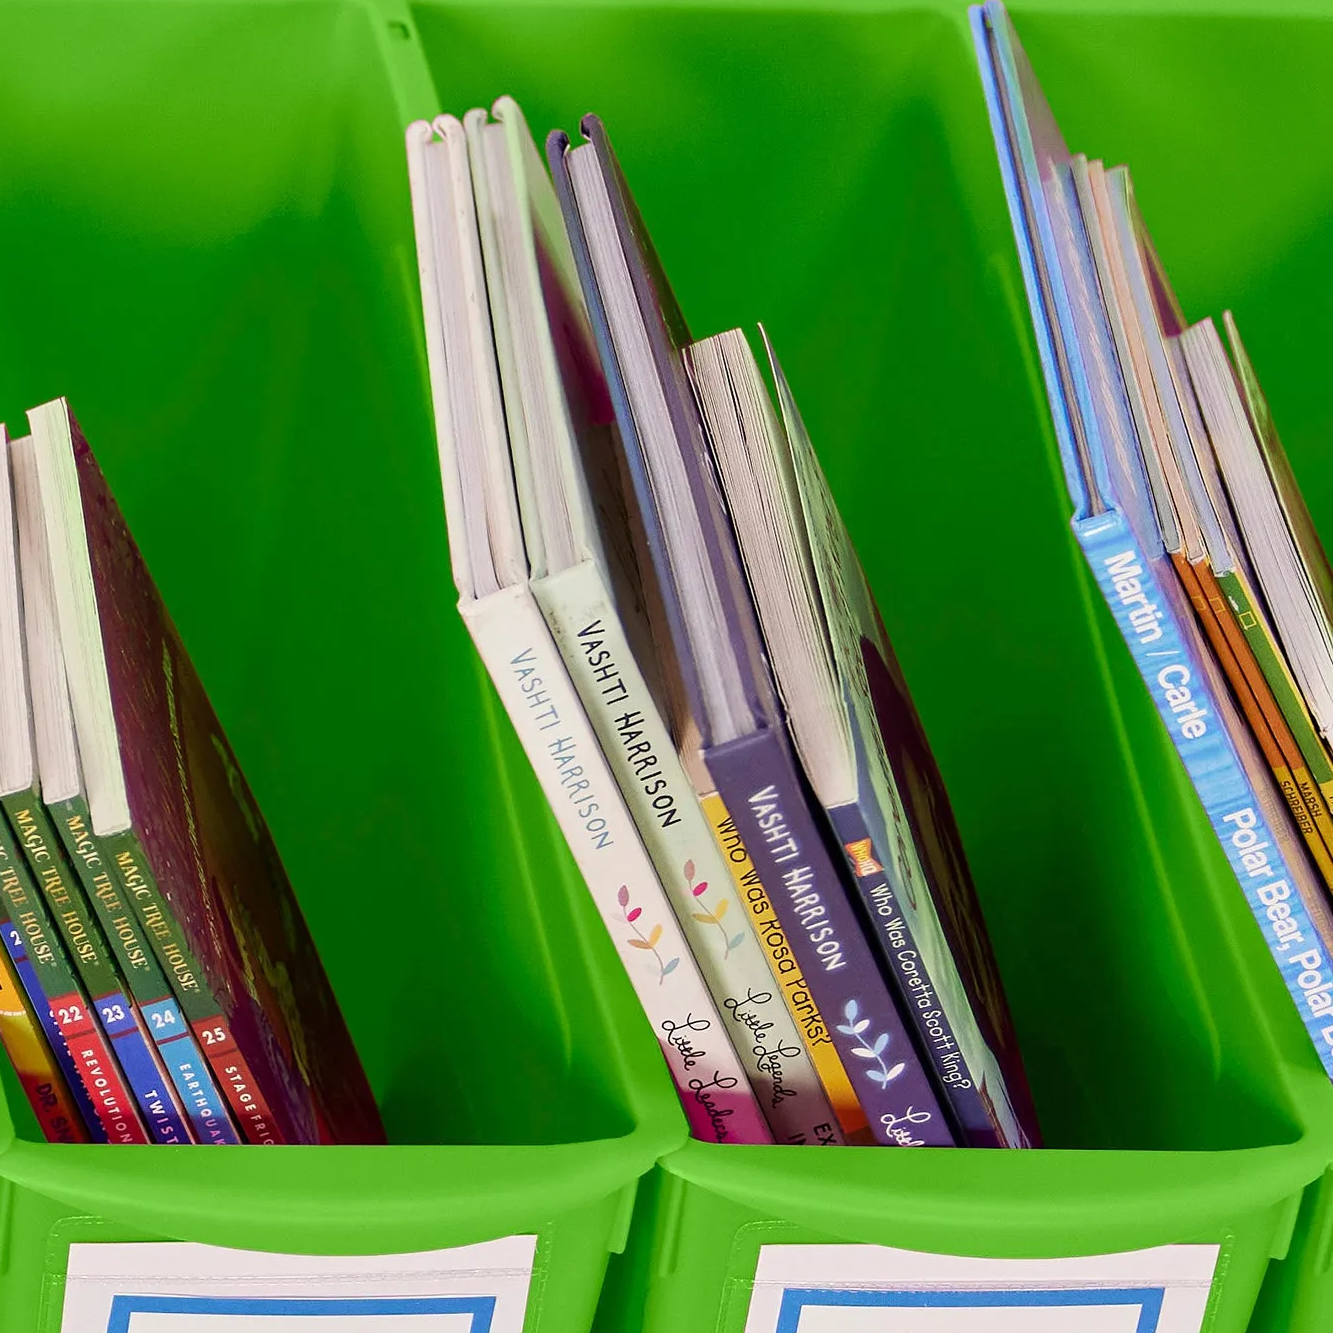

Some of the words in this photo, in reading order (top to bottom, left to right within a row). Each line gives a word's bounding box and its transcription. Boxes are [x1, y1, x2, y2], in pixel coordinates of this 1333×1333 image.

[1103, 549, 1164, 644] Martin
[1157, 664, 1208, 740] Carle
[510, 647, 562, 731] VASHTI
[548, 735, 614, 850] HARRISON
[576, 619, 630, 706] VASHTI
[614, 710, 681, 829] HARRISON
[1281, 779, 1313, 835] SCHREIBER
[1301, 780, 1323, 818] MARSH
[0, 866, 28, 909] TREE
[15, 809, 50, 863] MAGIC
[41, 865, 71, 908] TREE
[66, 814, 103, 869] MAGIC
[93, 871, 122, 913] TREE
[115, 851, 152, 901] MAGIC
[142, 902, 172, 940] TREE
[747, 784, 800, 864] VASHTI
[782, 866, 846, 972] HARRISON
[1222, 806, 1275, 878] Polar
[1256, 879, 1305, 951] Bear,
[717, 815, 748, 863] Who
[739, 868, 769, 915] Was
[760, 918, 796, 975] Rosa
[786, 977, 833, 1048] Parks?
[58, 1005, 83, 1025] 22
[102, 1004, 126, 1024] 23
[151, 1009, 176, 1028] 24
[870, 882, 892, 916] Who
[884, 916, 906, 949] Was
[897, 950, 933, 1009] Coretta
[923, 1009, 953, 1052] Scott
[940, 1044, 972, 1091] King?
[202, 1027, 226, 1045] 25
[661, 1012, 711, 1071] Little
[688, 1070, 738, 1143] Leaders
[724, 987, 774, 1043] Little
[752, 1039, 801, 1110] Legends
[81, 1049, 133, 1143] REVOLUTION
[144, 1089, 178, 1144] TWIST
[225, 1066, 256, 1111] STAGE
